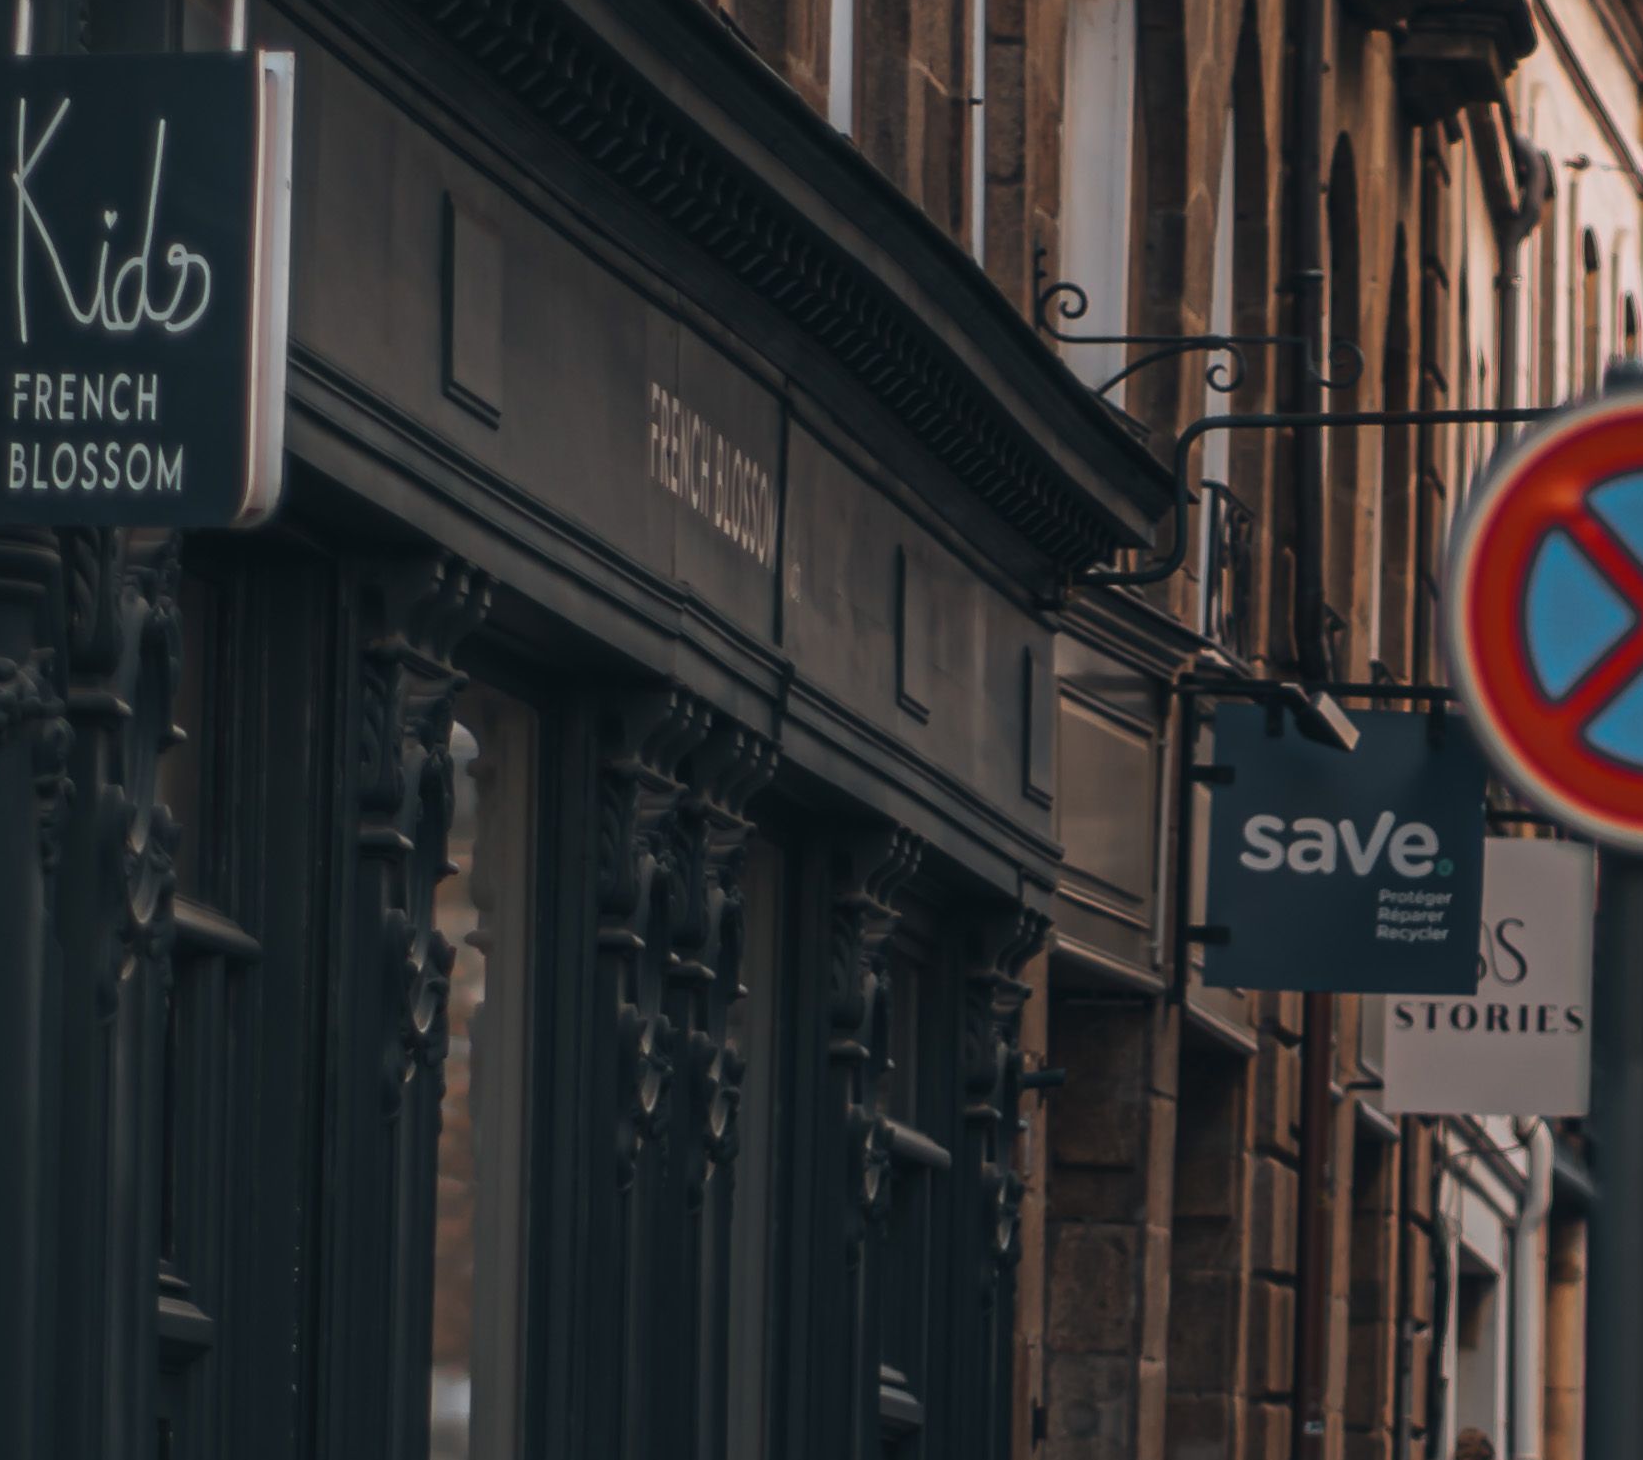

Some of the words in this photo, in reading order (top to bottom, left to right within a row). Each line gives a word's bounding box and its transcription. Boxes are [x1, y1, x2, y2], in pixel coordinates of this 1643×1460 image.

[10, 95, 212, 345] Kids
[10, 372, 160, 424] FRENCH
[8, 440, 185, 494] BLOSSOM
[650, 381, 712, 519] FRENCH
[1375, 905, 1446, 926] Réparer
[1377, 888, 1453, 908] Protéger
[1374, 924, 1449, 944] Recycler
[1393, 1001, 1586, 1035] STORIES
